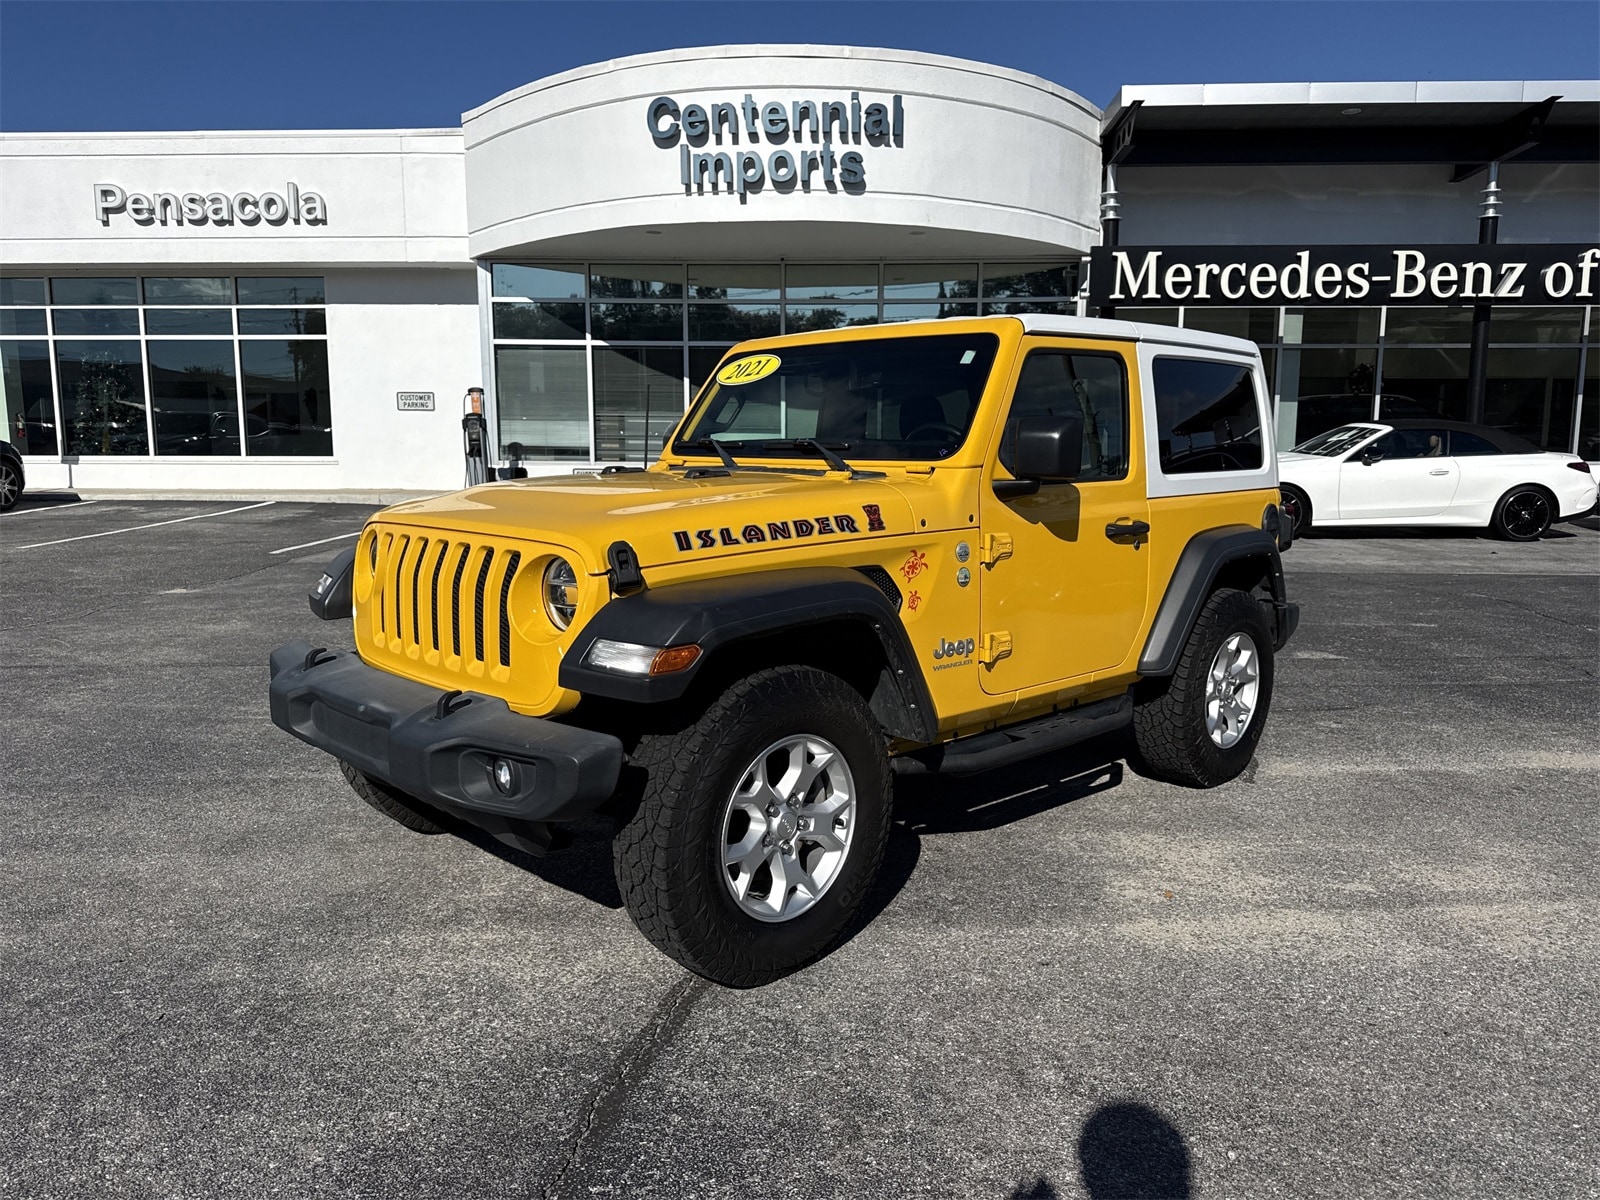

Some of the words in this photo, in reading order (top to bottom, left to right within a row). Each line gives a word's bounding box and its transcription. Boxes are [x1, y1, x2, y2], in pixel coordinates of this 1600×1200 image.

[647, 92, 904, 144] Centennial
[680, 143, 866, 197] Imports
[93, 182, 327, 225] Pensacola
[1109, 249, 1527, 299] Mercedes-Benz
[1544, 248, 1600, 298] of
[724, 358, 772, 380] 2021
[673, 514, 860, 552] ISLANDER
[932, 659, 973, 671] WRANGLER
[933, 637, 975, 660] Jeep
